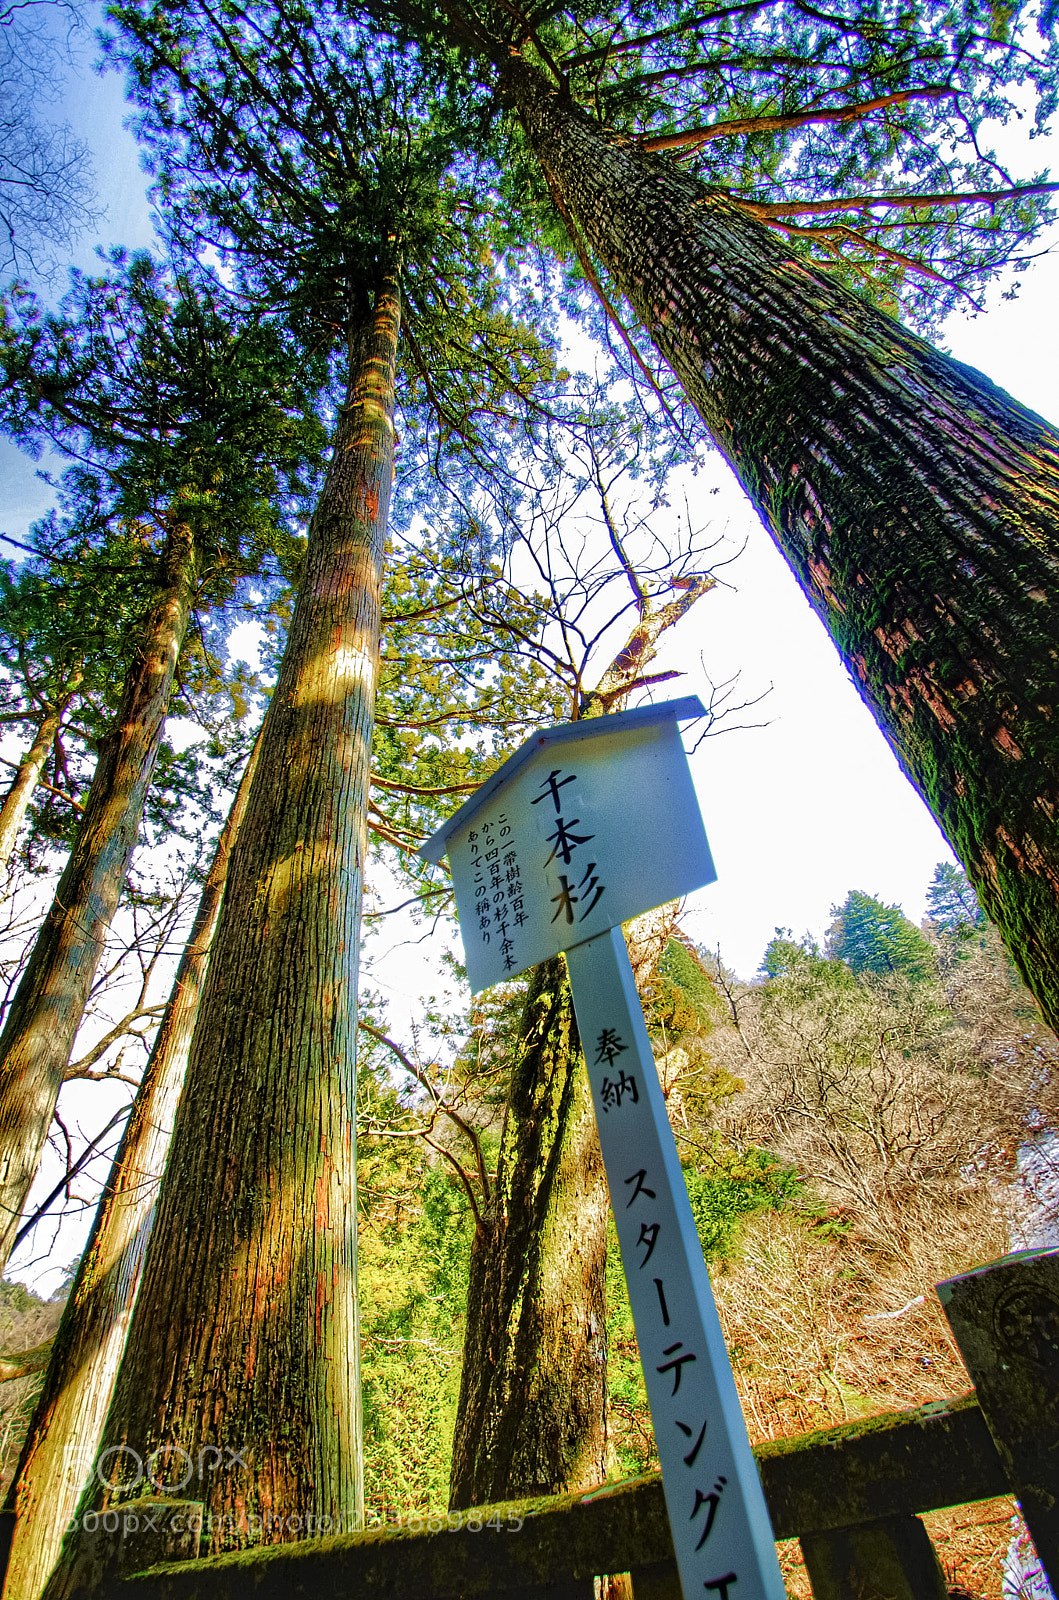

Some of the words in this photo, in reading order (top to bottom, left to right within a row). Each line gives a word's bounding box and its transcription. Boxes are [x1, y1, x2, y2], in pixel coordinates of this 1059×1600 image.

[531, 770, 605, 925] 千本杉
[594, 1028, 639, 1112] 奉納
